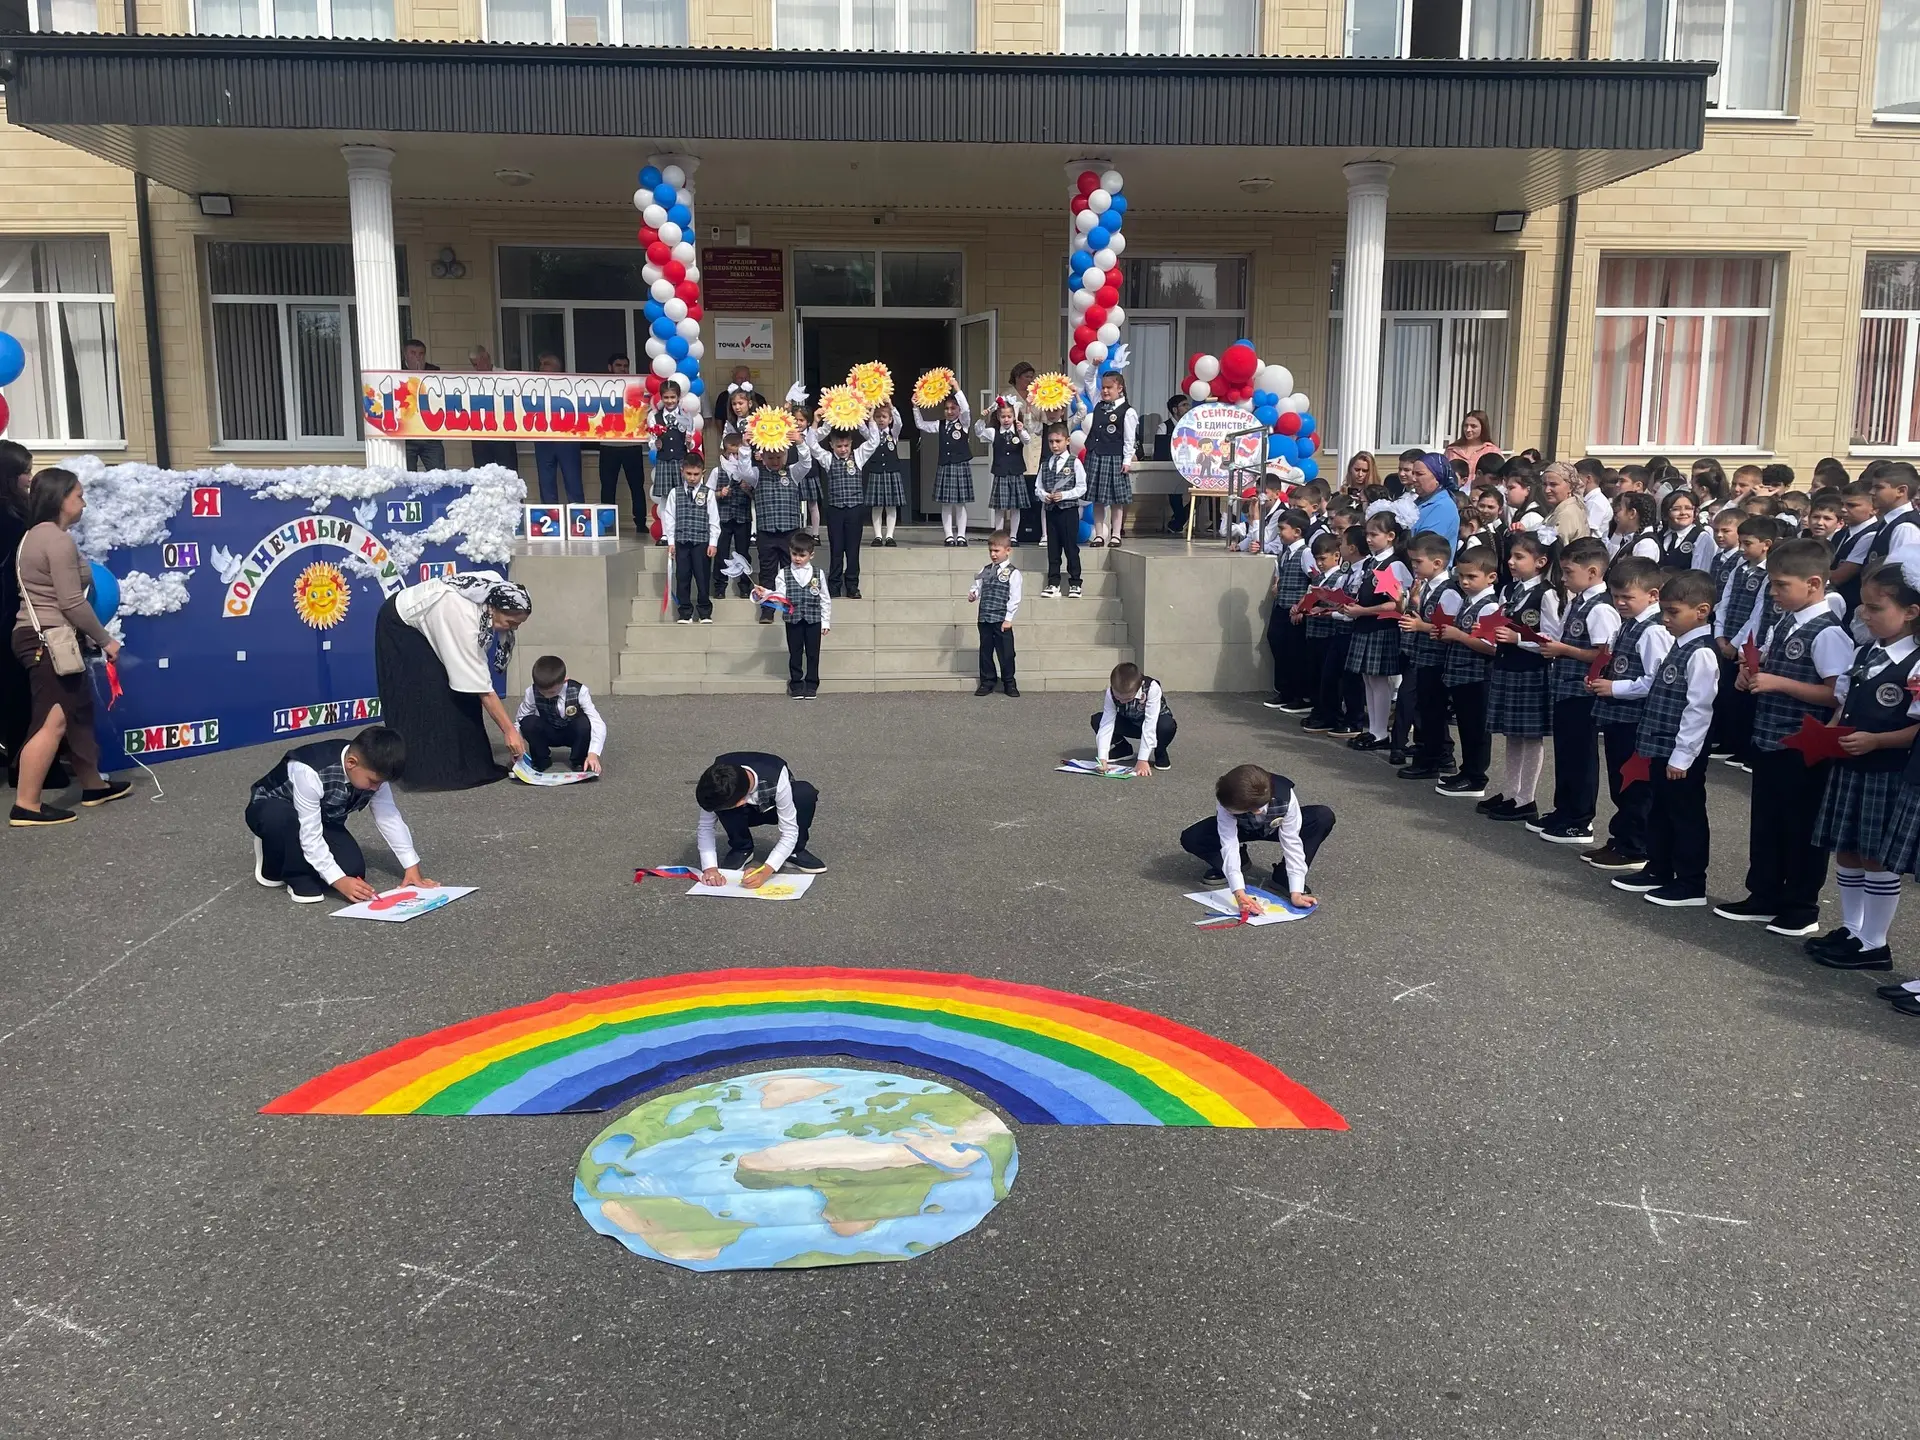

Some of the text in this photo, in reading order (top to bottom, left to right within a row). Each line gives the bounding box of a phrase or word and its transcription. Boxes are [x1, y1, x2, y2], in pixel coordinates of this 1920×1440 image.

[379, 375, 627, 432] 1 СЕНТЯБРЯ
[1193, 408, 1253, 423] 1 СЕНТЯБРЯ
[1196, 421, 1202, 429] В
[1204, 421, 1247, 430] ЕДИНСТВЕ
[193, 488, 220, 516] Я
[387, 502, 421, 522] ТЫ
[164, 543, 199, 568] ОН
[226, 519, 353, 616] СОЛНЕЧНЫЙ
[275, 698, 381, 732] ДРУЖНАЯ
[125, 719, 219, 753] ВМЕСТЕ
